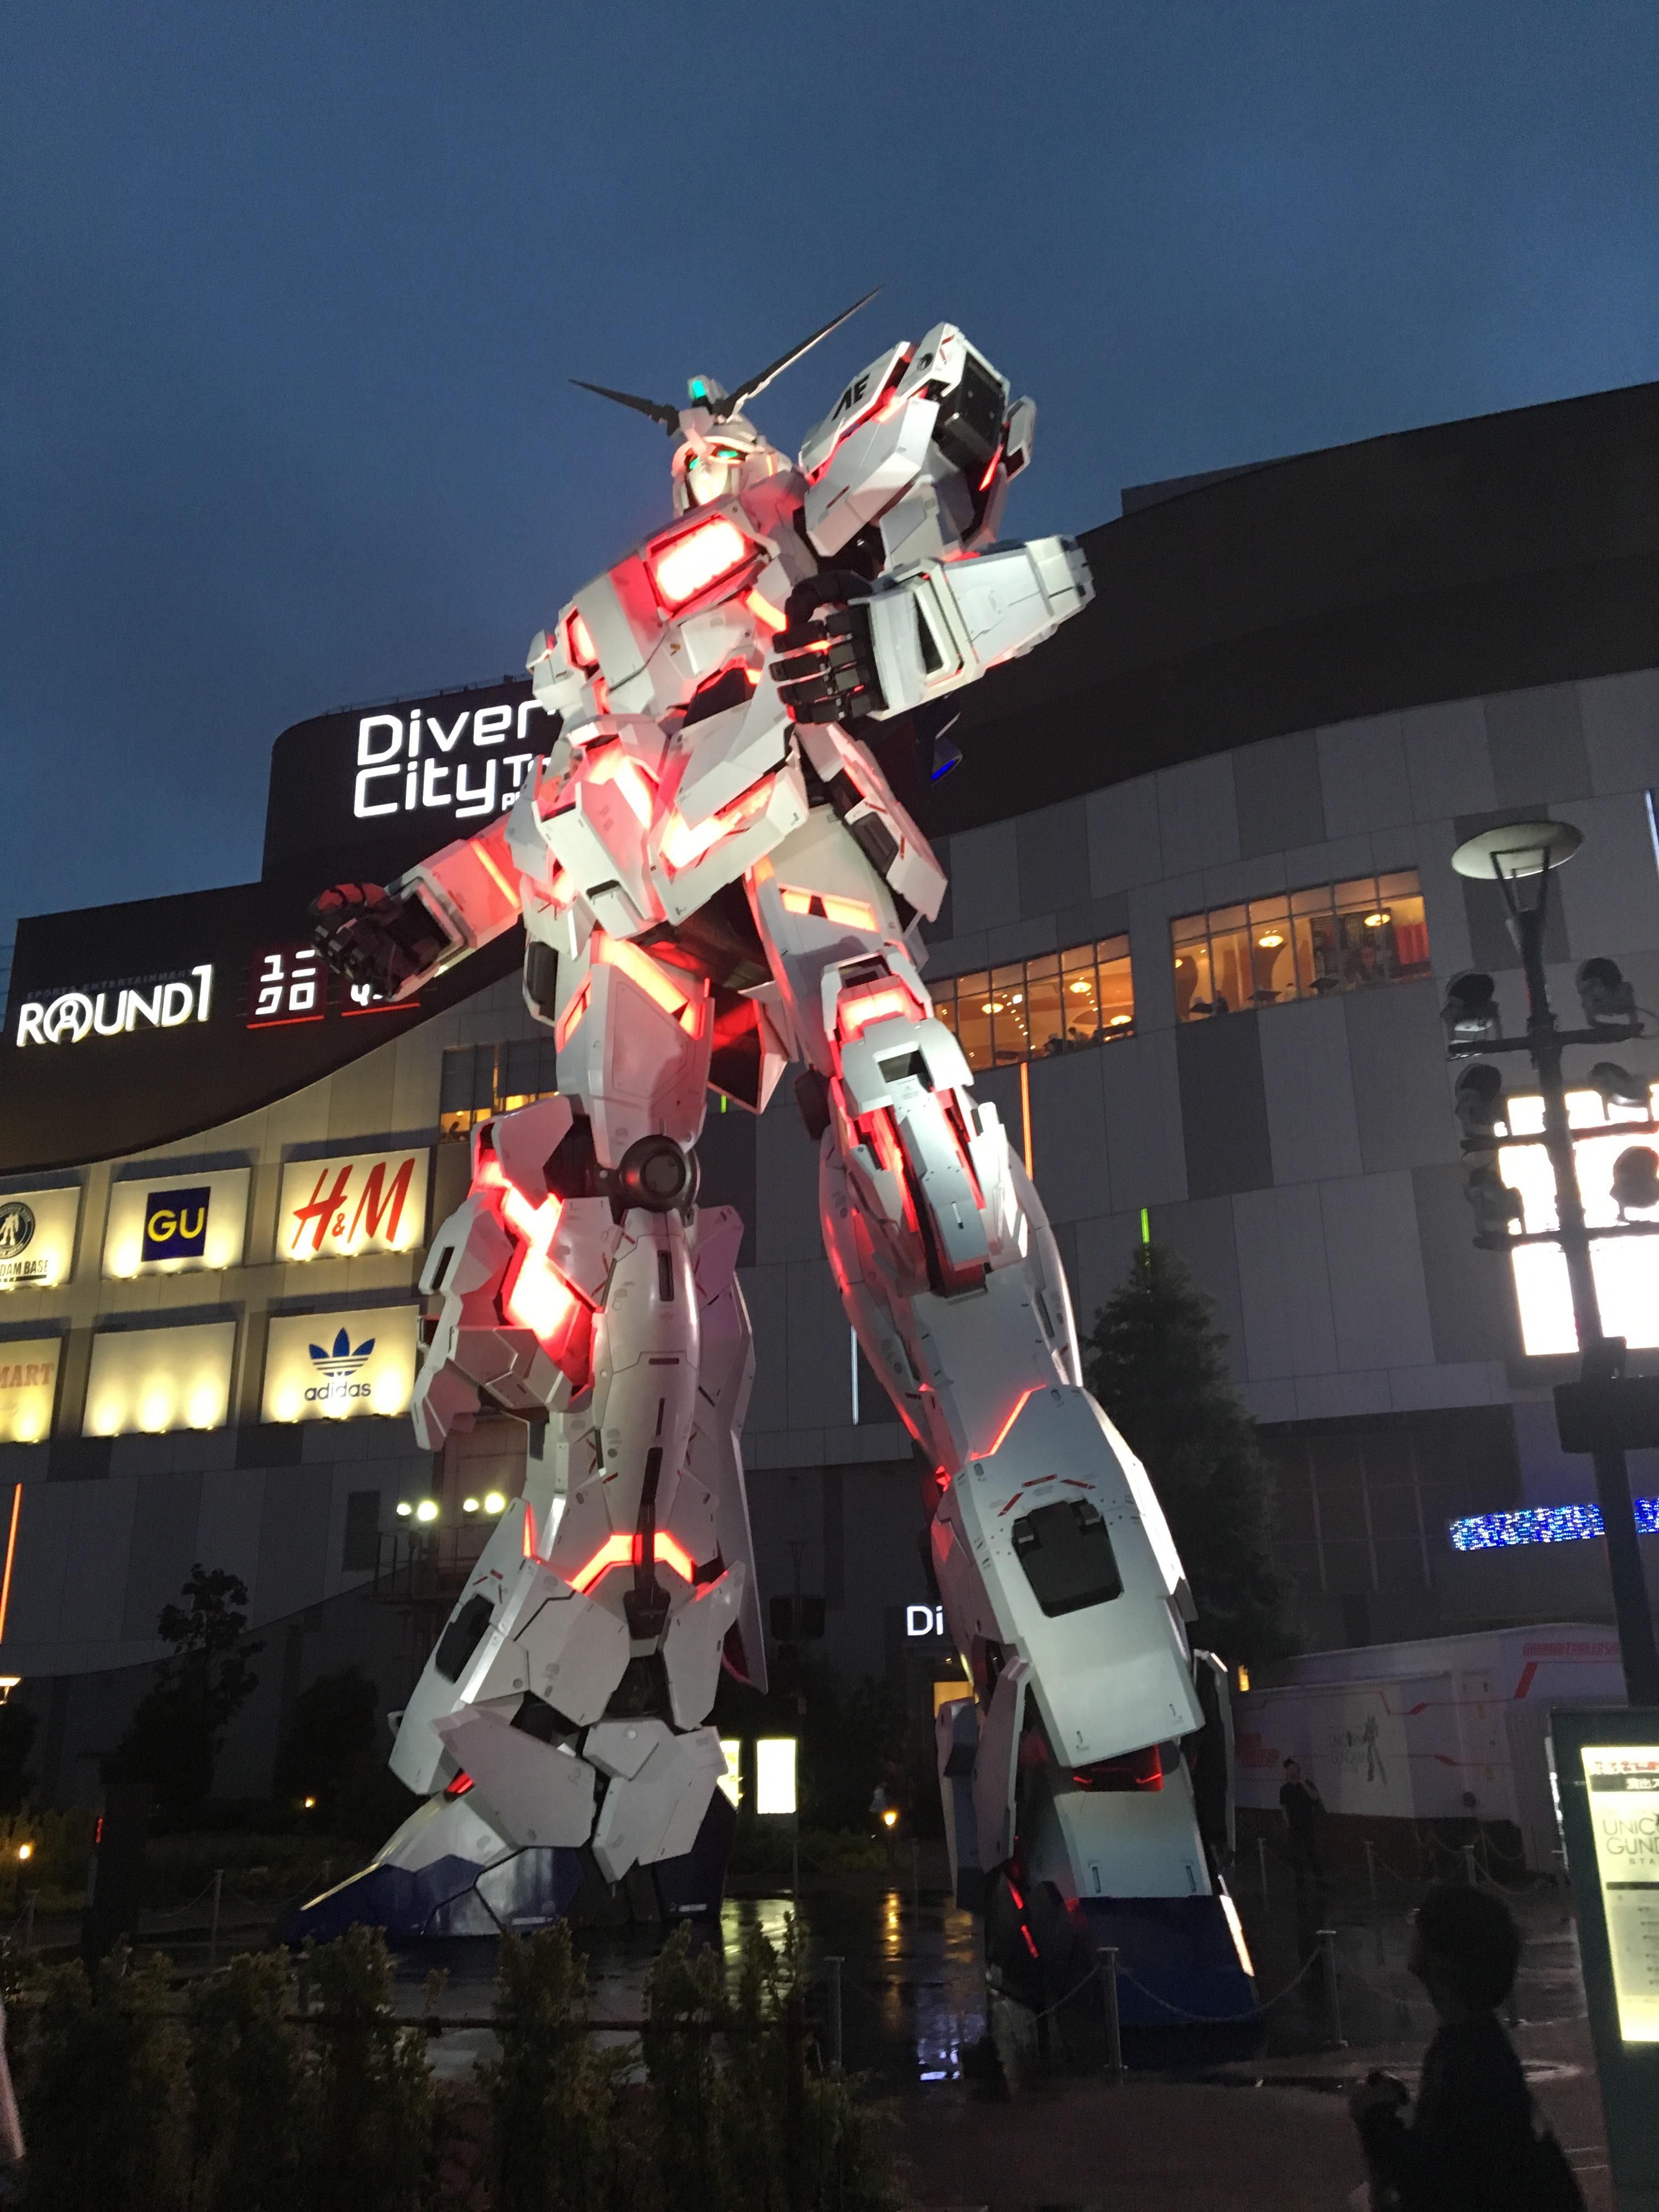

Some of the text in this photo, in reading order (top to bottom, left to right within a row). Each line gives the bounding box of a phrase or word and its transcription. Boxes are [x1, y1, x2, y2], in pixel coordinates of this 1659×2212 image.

[358, 699, 556, 766] Diver
[354, 758, 496, 818] City
[16, 964, 212, 1047] ROUND1
[148, 1207, 205, 1242] GU
[293, 1158, 415, 1251] H&M
[24, 1260, 48, 1274] BASE
[304, 1381, 371, 1401] adidas
[1602, 1818, 1659, 1836] UNIC
